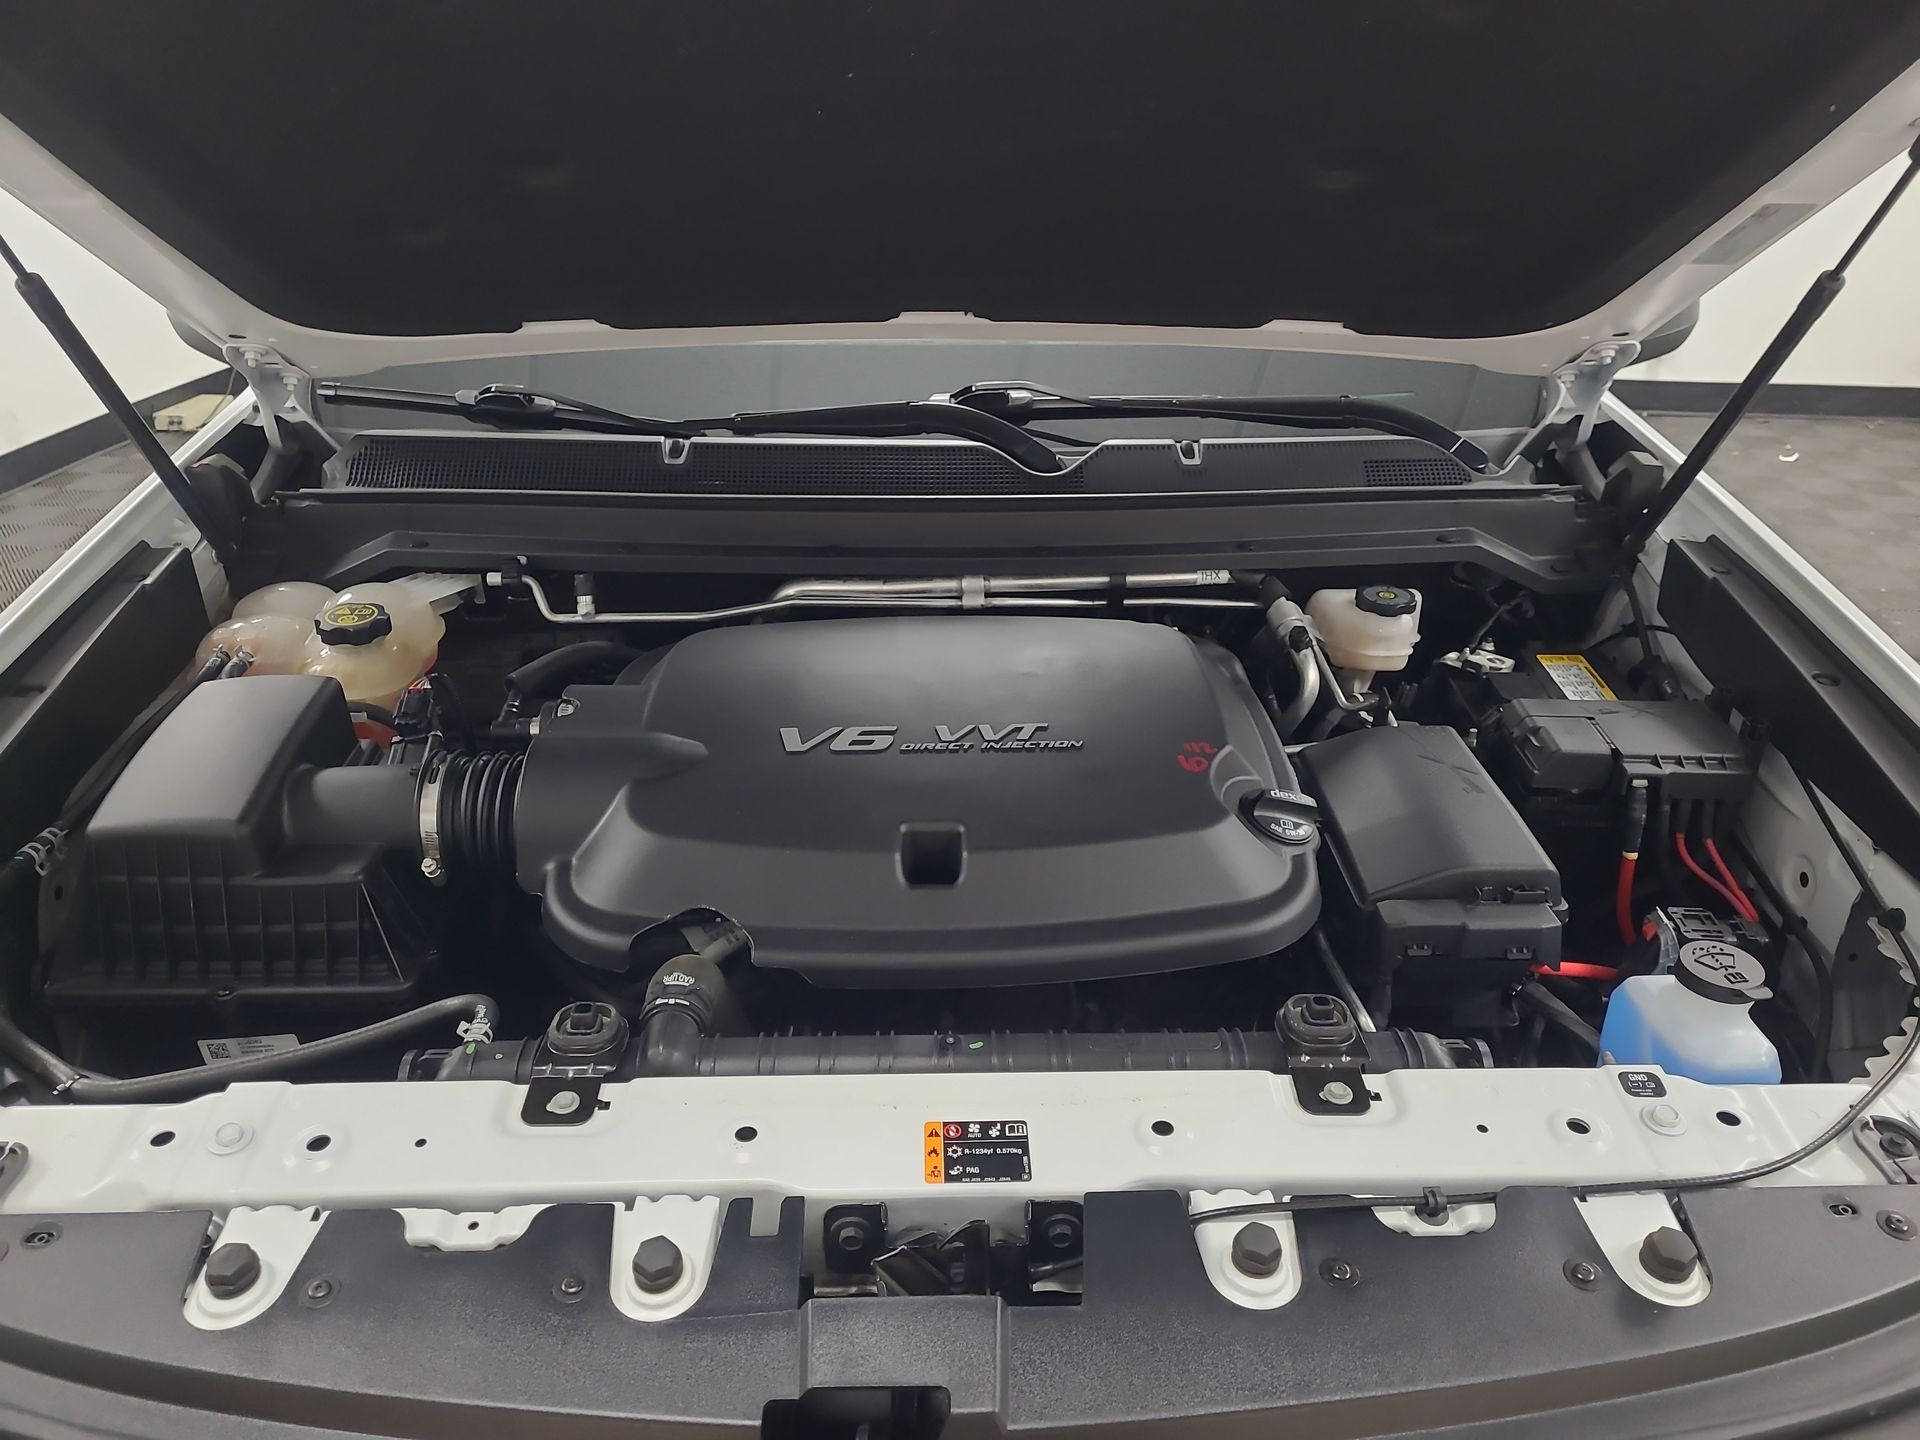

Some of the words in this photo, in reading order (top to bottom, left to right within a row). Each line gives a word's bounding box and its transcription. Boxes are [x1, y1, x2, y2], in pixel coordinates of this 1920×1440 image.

[935, 722, 1048, 741] VVT
[779, 725, 898, 752] V6
[900, 742, 974, 750] DIRECT
[980, 740, 1083, 749] INJECTION
[679, 974, 695, 984] RAD
[1628, 1073, 1648, 1081] GND
